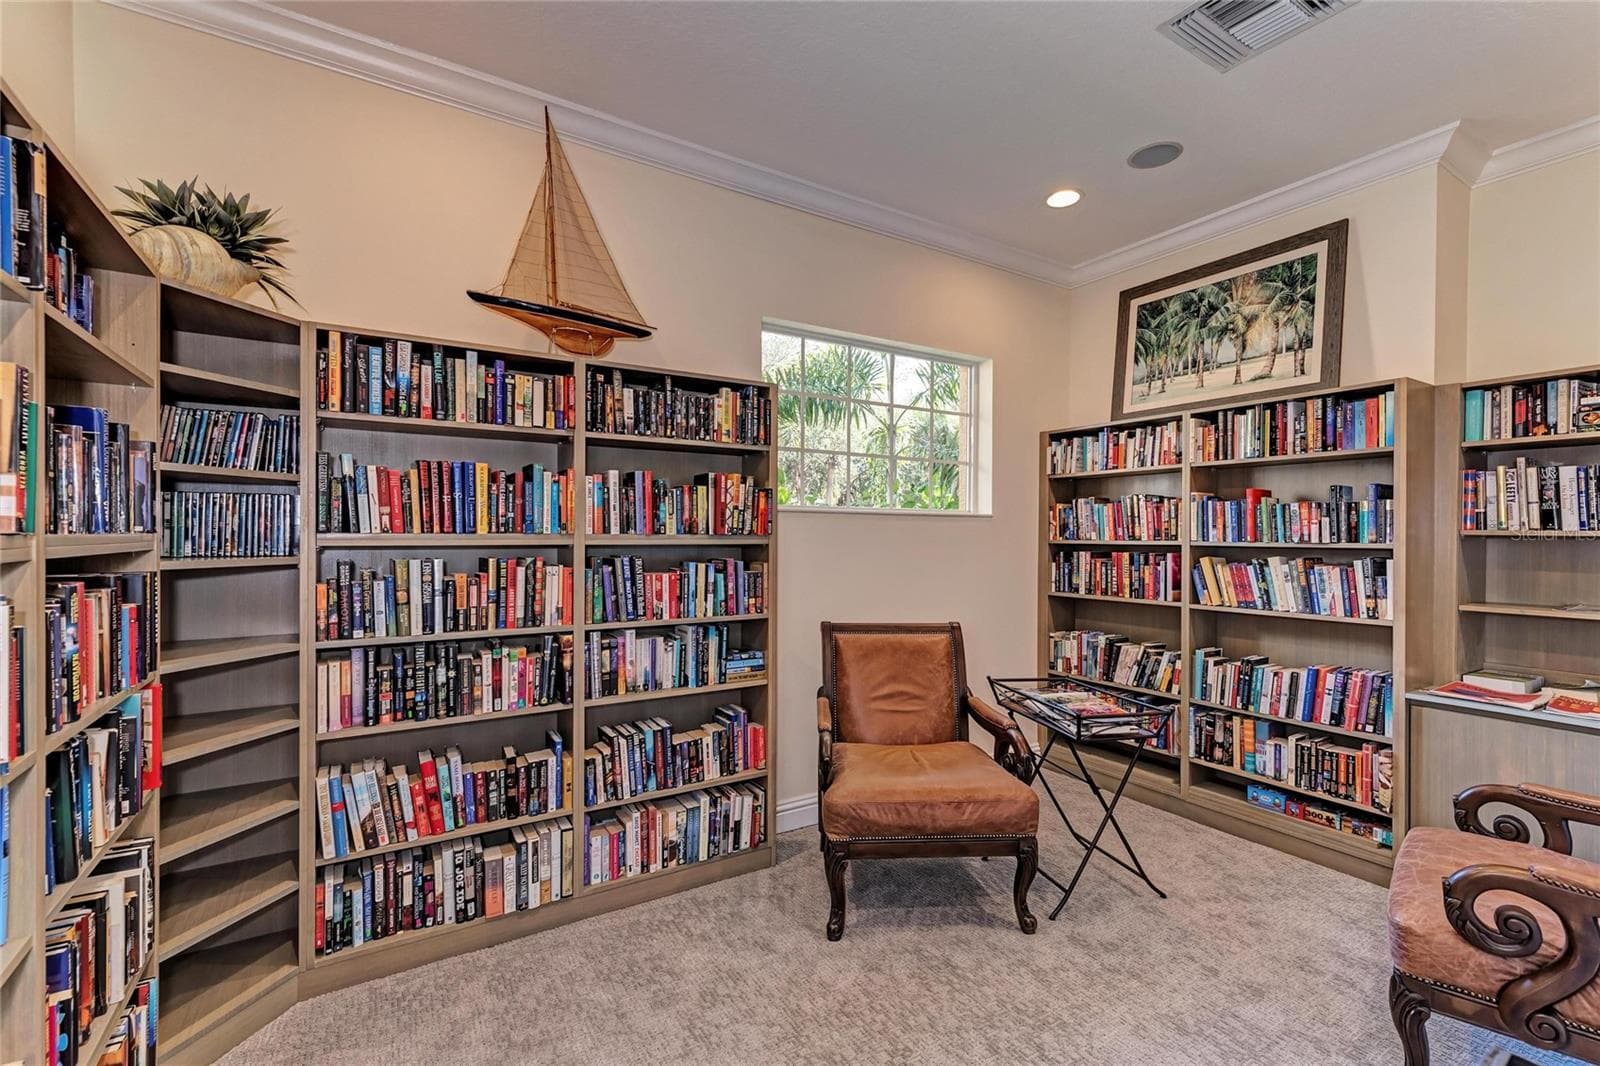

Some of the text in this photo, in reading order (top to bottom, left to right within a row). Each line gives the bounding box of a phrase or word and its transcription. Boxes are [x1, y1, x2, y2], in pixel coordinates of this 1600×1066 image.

[434, 352, 443, 369] CHINA
[434, 369, 443, 384] LAKE
[319, 453, 328, 492] TESS GERRITSEN
[1506, 481, 1516, 504] LEFTY
[422, 561, 432, 604] JOHN GRISHAM
[635, 558, 644, 598] DEAN KOONTZ
[340, 590, 349, 626] DAKOTA
[72, 653, 81, 702] NAVIGATOR
[415, 648, 425, 693] PACIFIC HEIGHTS
[455, 852, 465, 911] IQ JOE IDE
